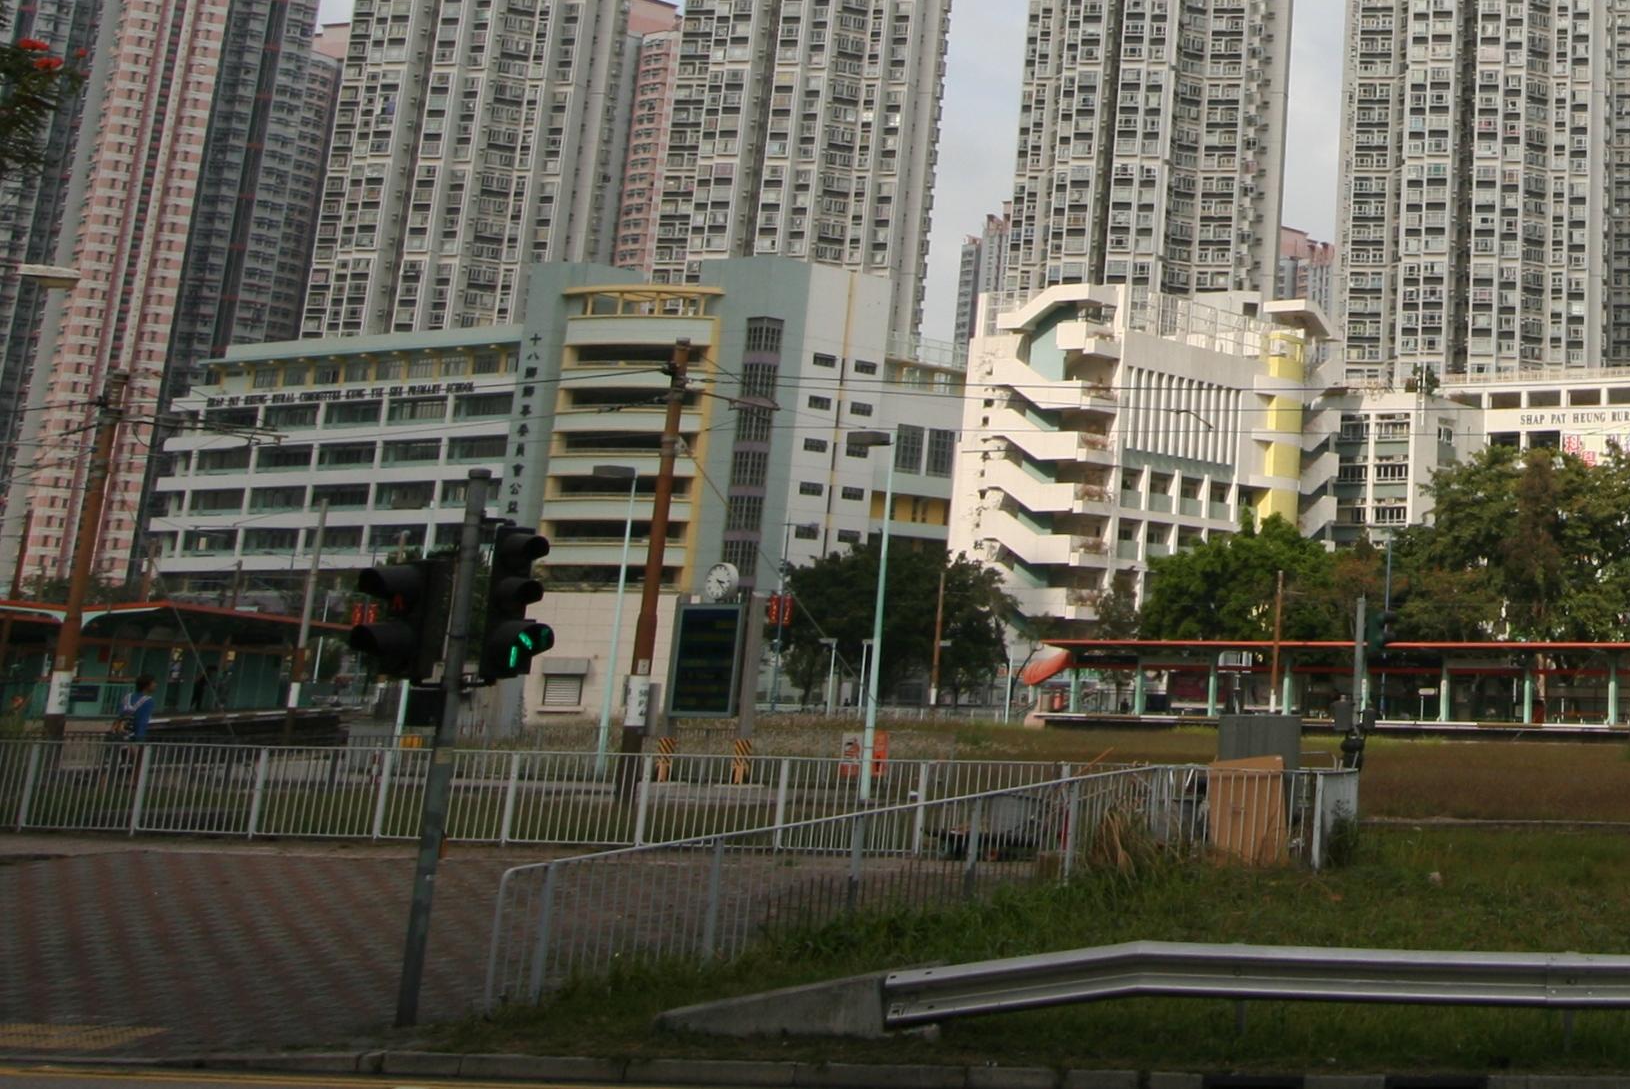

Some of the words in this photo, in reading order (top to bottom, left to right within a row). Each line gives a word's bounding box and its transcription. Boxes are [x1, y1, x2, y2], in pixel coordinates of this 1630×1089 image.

[1520, 414, 1545, 425] SHAP
[1551, 413, 1566, 424] PAT
[1573, 412, 1605, 423] HEUNG
